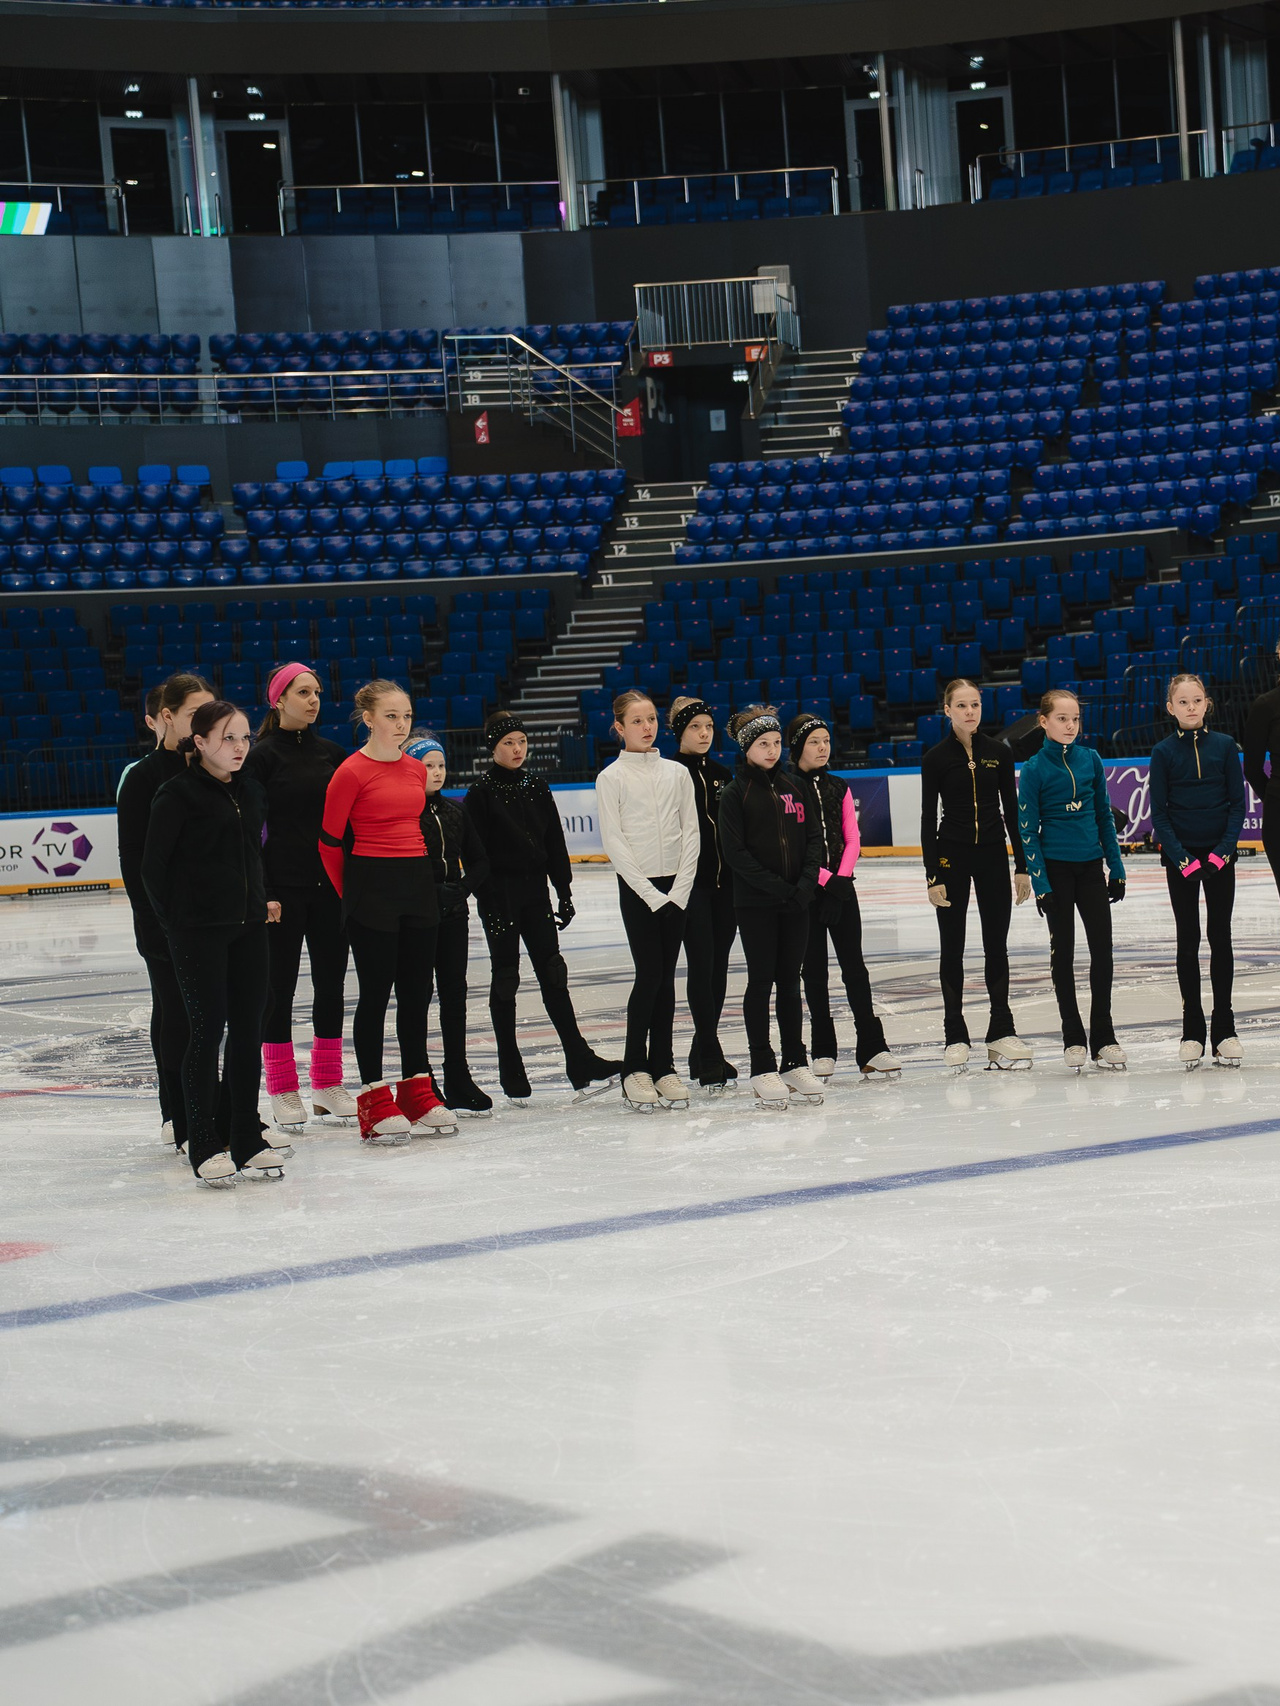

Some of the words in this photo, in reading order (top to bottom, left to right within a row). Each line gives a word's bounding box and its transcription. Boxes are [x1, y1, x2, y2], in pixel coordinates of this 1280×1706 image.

[653, 354, 670, 365] P3
[466, 395, 480, 405] 18
[828, 426, 841, 437] 16
[637, 489, 650, 501] 14
[1269, 495, 1280, 506] 12
[625, 517, 639, 528] 13
[613, 545, 627, 556] 12
[601, 574, 613, 586] 11
[1066, 800, 1082, 812] FLY
[42, 842, 67, 857] TV
